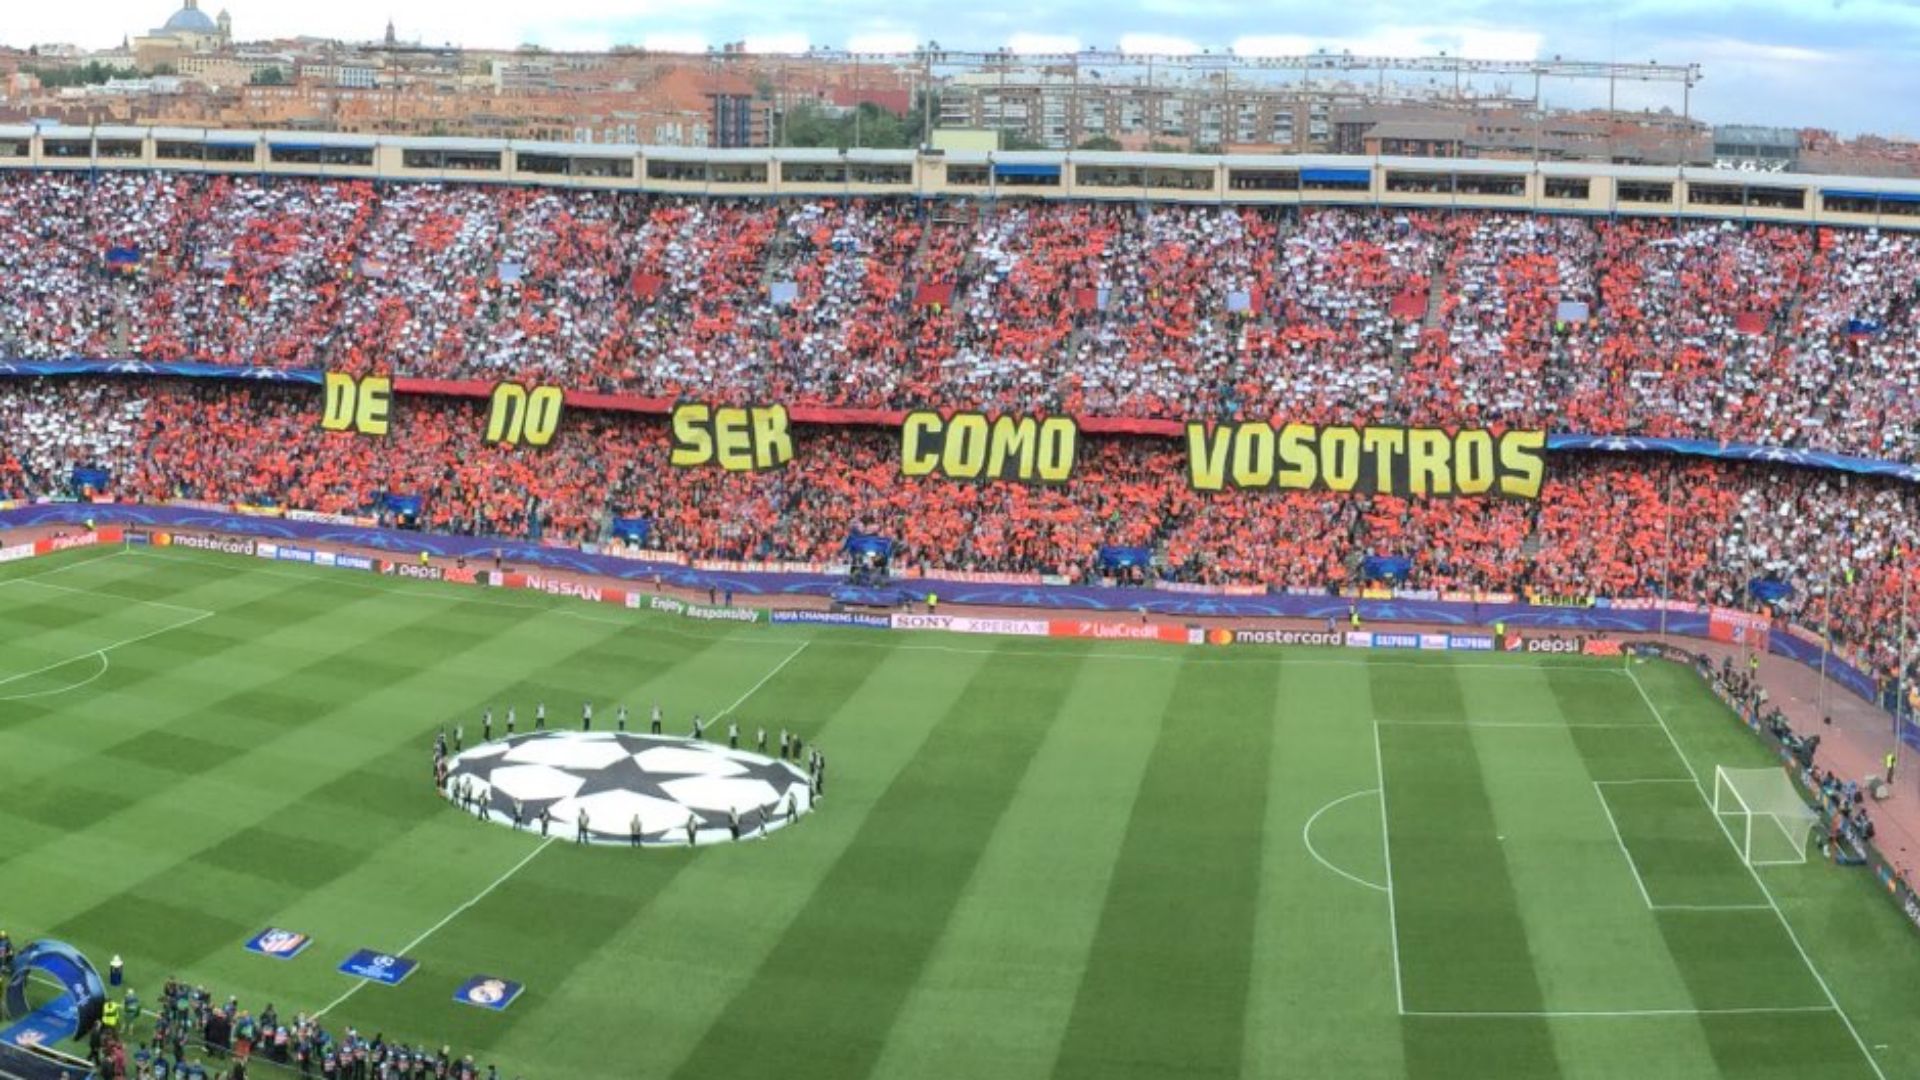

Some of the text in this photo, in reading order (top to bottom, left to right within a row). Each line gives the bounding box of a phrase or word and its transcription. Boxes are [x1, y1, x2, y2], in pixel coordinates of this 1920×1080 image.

[321, 372, 1544, 498] DE NO SER COMO VOSOTROS
[173, 534, 254, 556] mastercard
[399, 566, 441, 580] pepsi
[526, 574, 602, 601] NISSAN
[651, 597, 759, 622] Enjoy Responsibly
[897, 616, 953, 627] SONY
[968, 619, 1030, 632] XPERIA
[1093, 622, 1159, 639] UniCredit
[1236, 629, 1341, 646] mastercard
[1529, 638, 1579, 653] pepsi
